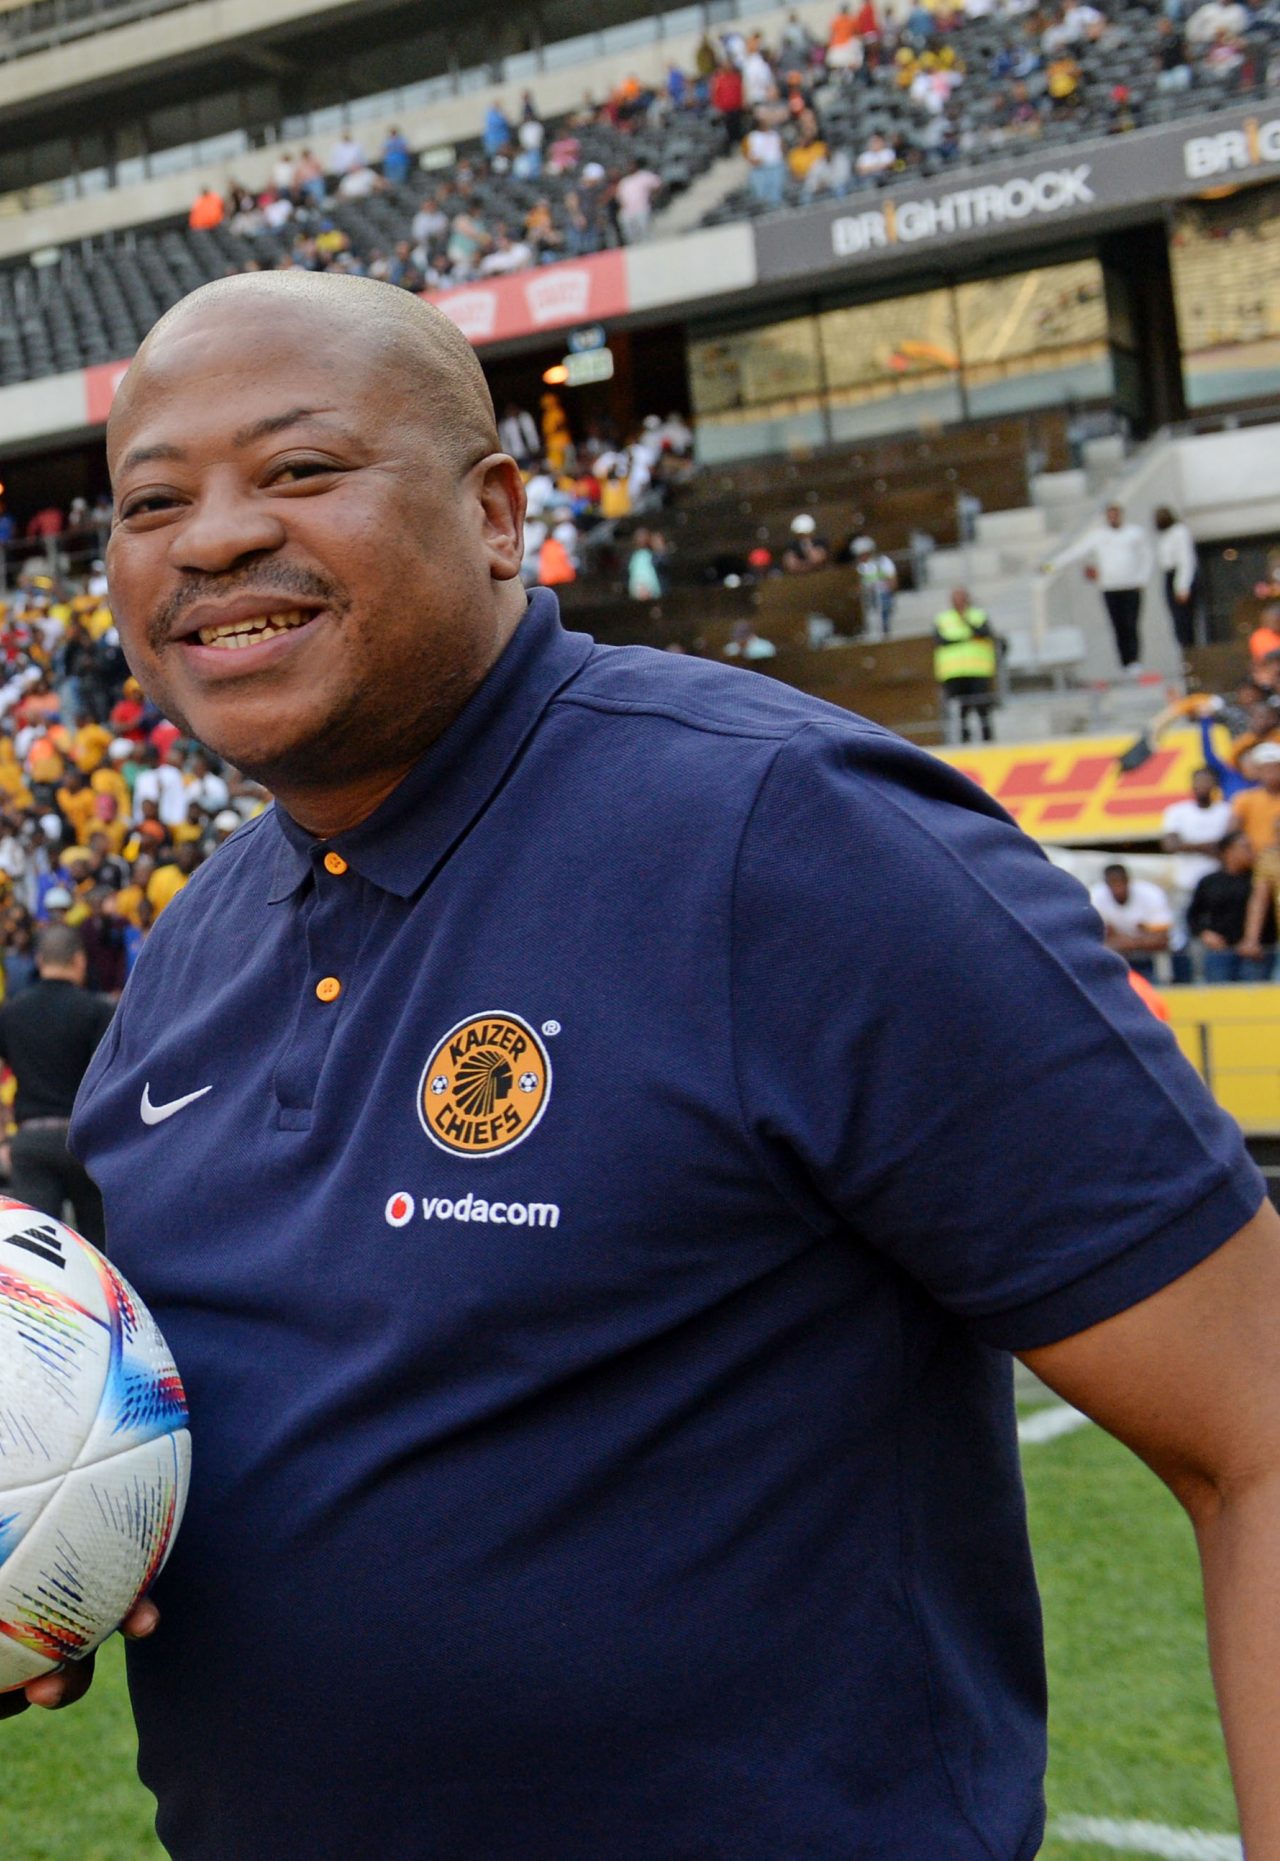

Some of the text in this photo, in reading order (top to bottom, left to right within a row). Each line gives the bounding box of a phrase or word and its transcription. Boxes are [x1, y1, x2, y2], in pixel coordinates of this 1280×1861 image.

[831, 163, 1096, 257] BRIGHTROCK
[449, 1024, 527, 1066] KAIZER
[434, 1102, 522, 1144] CHIEFS
[422, 1192, 560, 1228] vodacom
